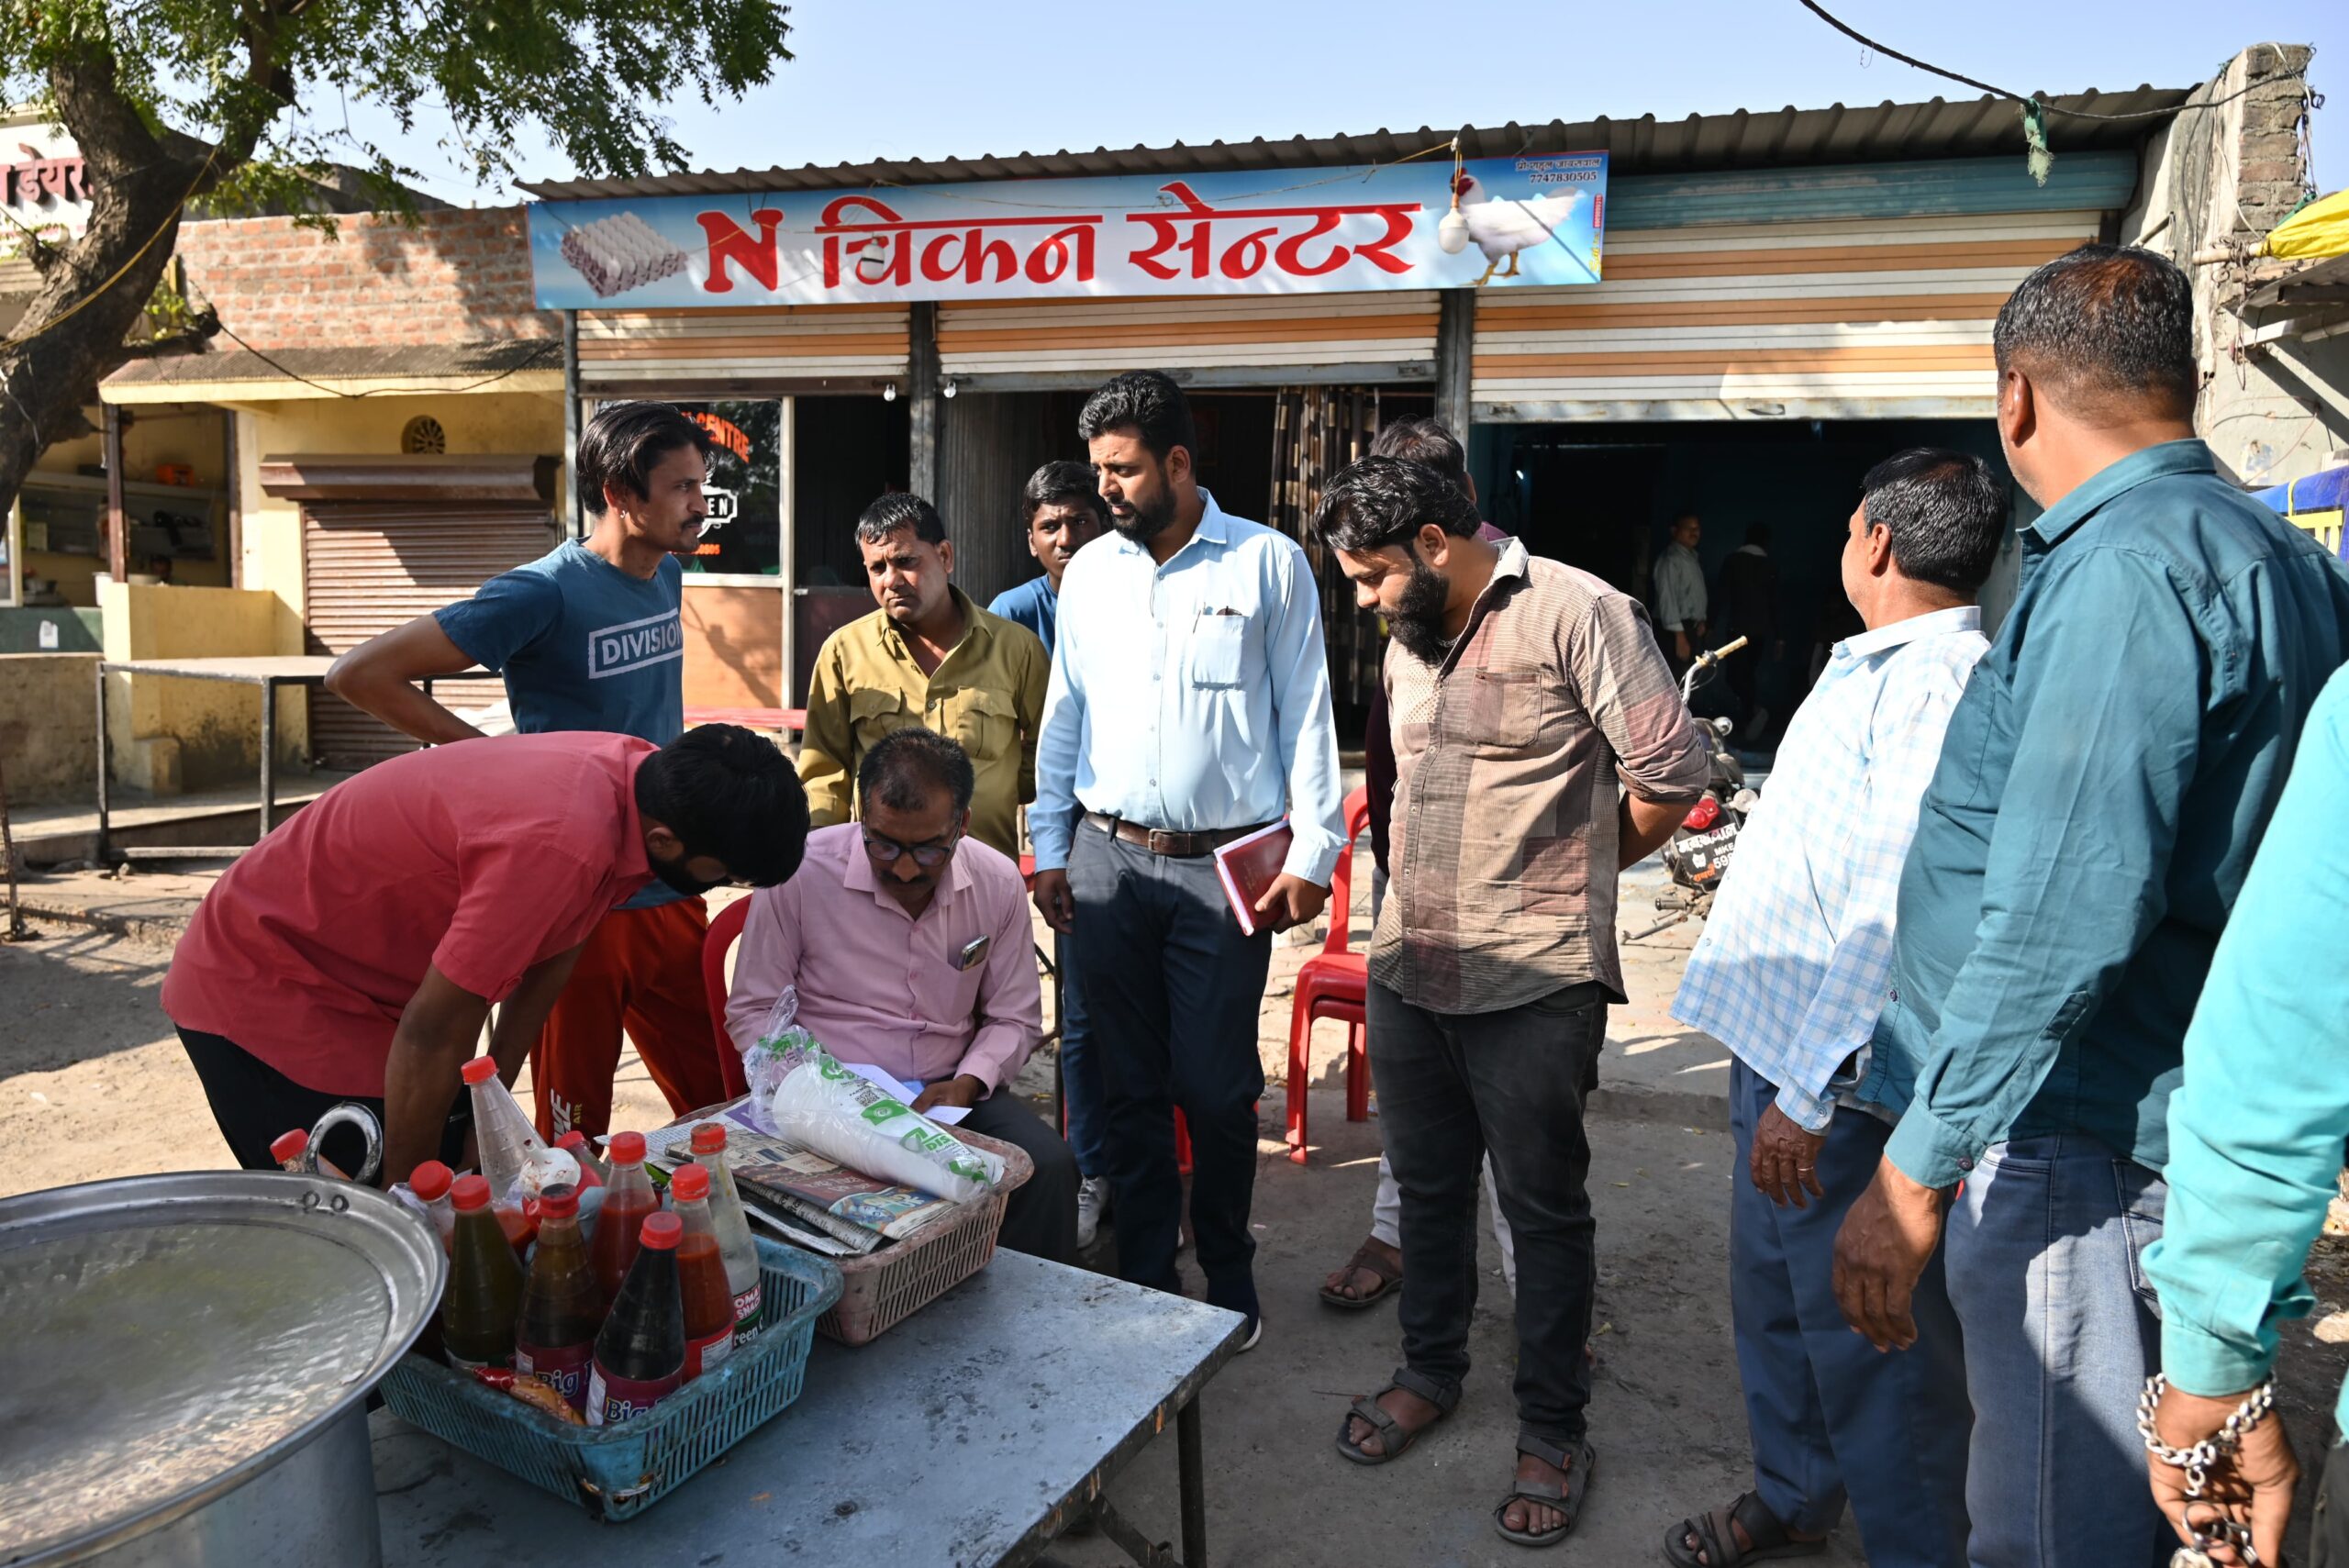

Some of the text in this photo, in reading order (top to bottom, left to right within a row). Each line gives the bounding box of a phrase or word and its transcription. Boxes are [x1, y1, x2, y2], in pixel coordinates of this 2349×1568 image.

[16, 142, 94, 201] डेयर
[1530, 171, 1598, 184] 7747830505
[696, 180, 1421, 294] N चिकन सेन्टर
[573, 1104, 582, 1124] AIR
[734, 1327, 759, 1346] reen
